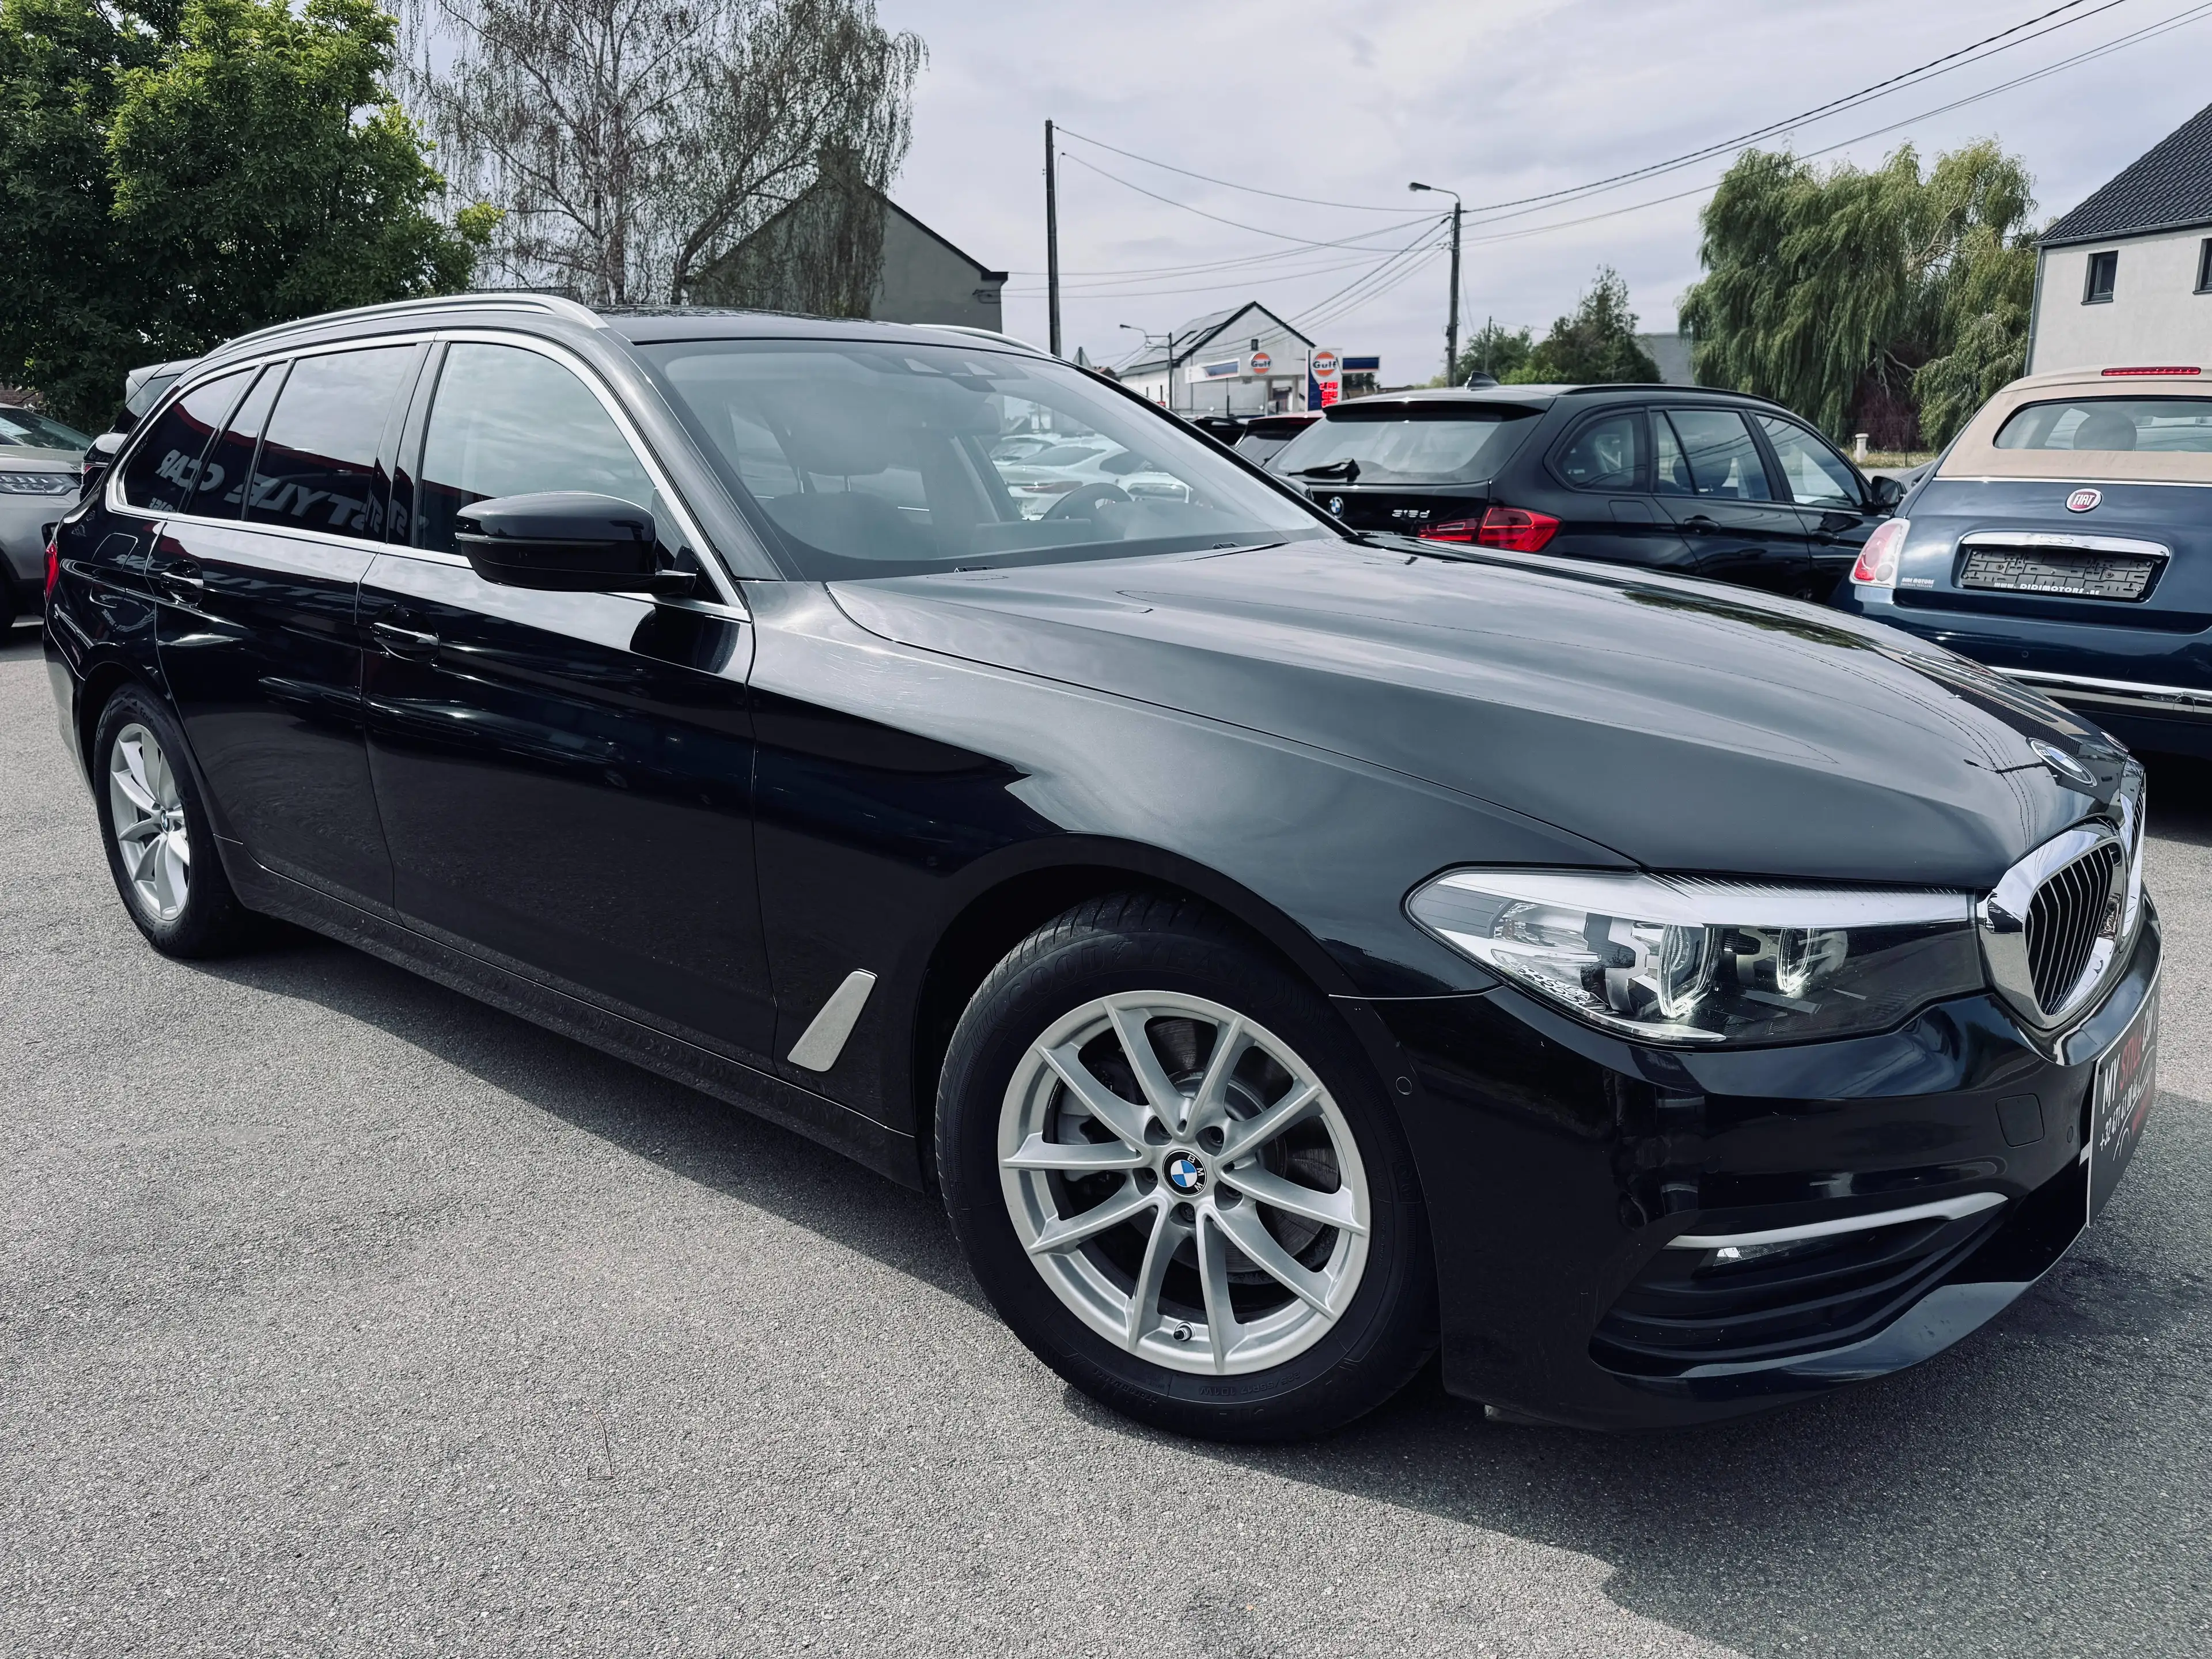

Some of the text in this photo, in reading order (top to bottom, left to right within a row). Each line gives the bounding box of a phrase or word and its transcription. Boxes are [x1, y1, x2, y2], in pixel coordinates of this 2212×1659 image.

[1313, 361, 1337, 369] Gulf
[2072, 494, 2096, 506] FIAT
[2102, 1053, 2120, 1115] MY
[1187, 1154, 1205, 1191] BMW
